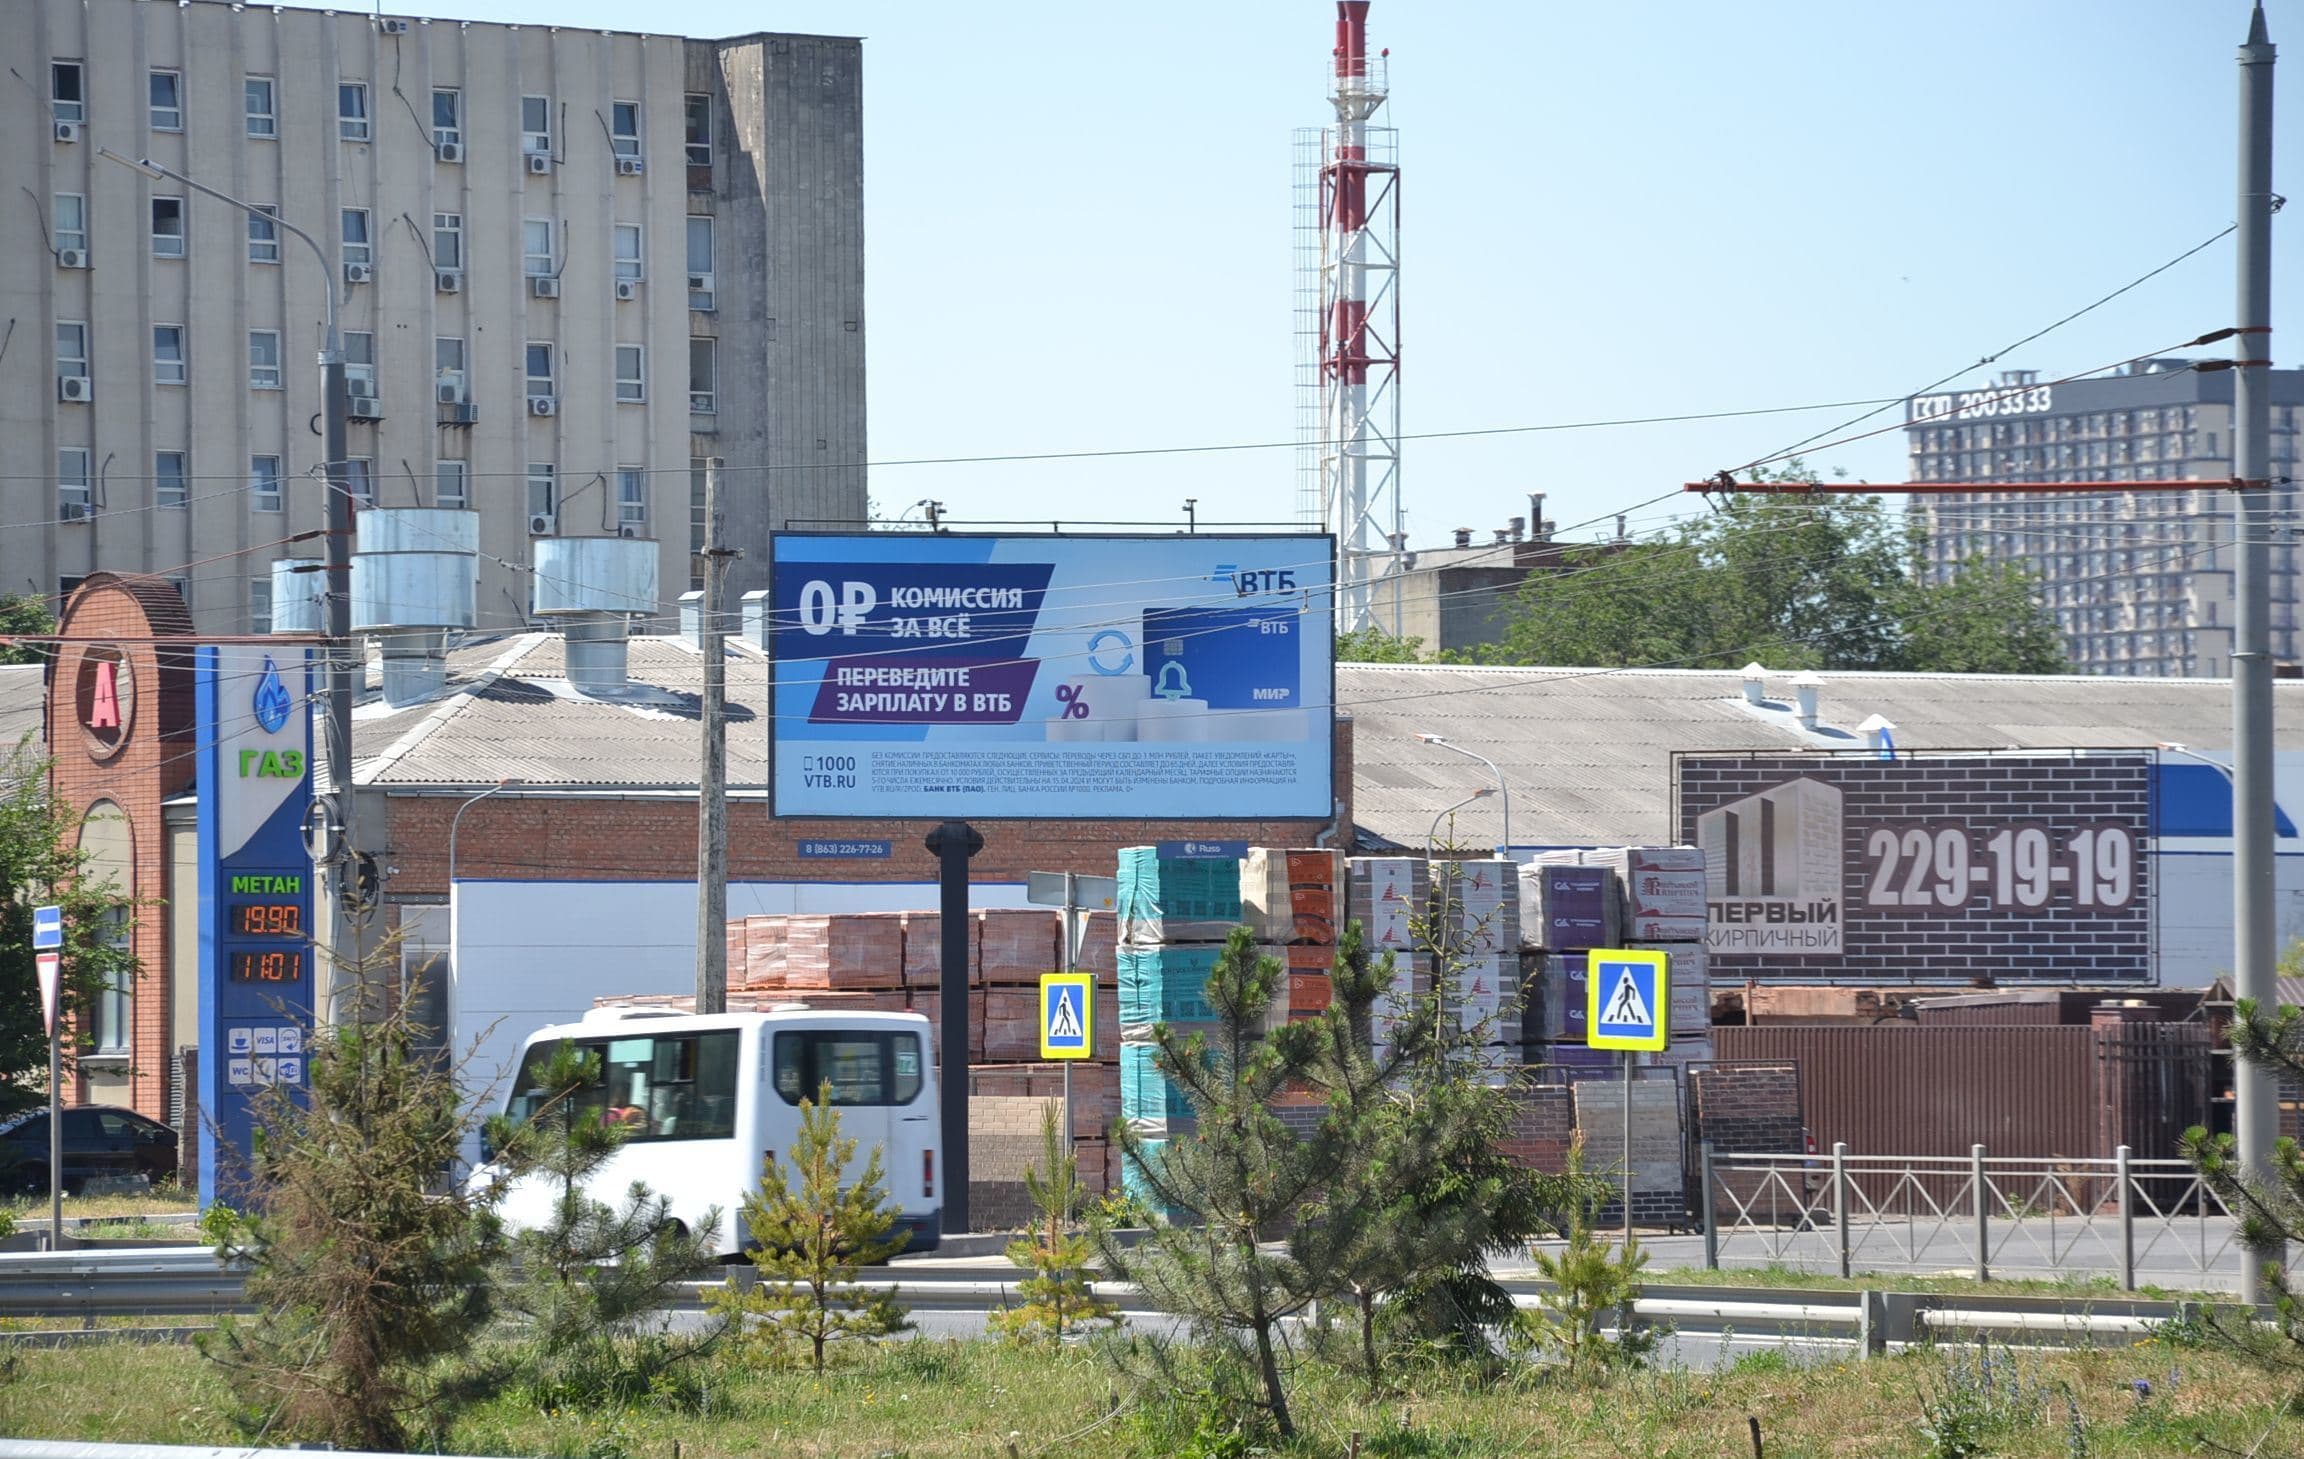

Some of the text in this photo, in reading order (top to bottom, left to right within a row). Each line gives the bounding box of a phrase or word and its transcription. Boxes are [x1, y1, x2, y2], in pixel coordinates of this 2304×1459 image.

[1240, 570, 1297, 596] ВТБ
[891, 587, 1023, 609] КОМИССИЯ
[891, 613, 972, 638] ЗА ВСЁ
[1261, 621, 1289, 635] ВТБ
[837, 667, 970, 690] ПЕРЕВЕДИТЕ
[836, 692, 1012, 712] ЗАРПЛАТУ В ВТБ
[1253, 688, 1290, 700] МИР
[239, 749, 305, 778] ГАЗ
[816, 756, 856, 771] 1000
[804, 774, 856, 788] VTB.RU
[806, 843, 883, 855] 8 (863) 226-77-26
[1868, 828, 2131, 907] 229-19-19
[232, 876, 300, 894] МЕТАН
[243, 906, 298, 933] 19.90
[1707, 897, 1837, 924] ПЕРВЫЙ
[244, 953, 300, 980] 11:01
[256, 1036, 275, 1045] VISA
[232, 1067, 249, 1076] WC
